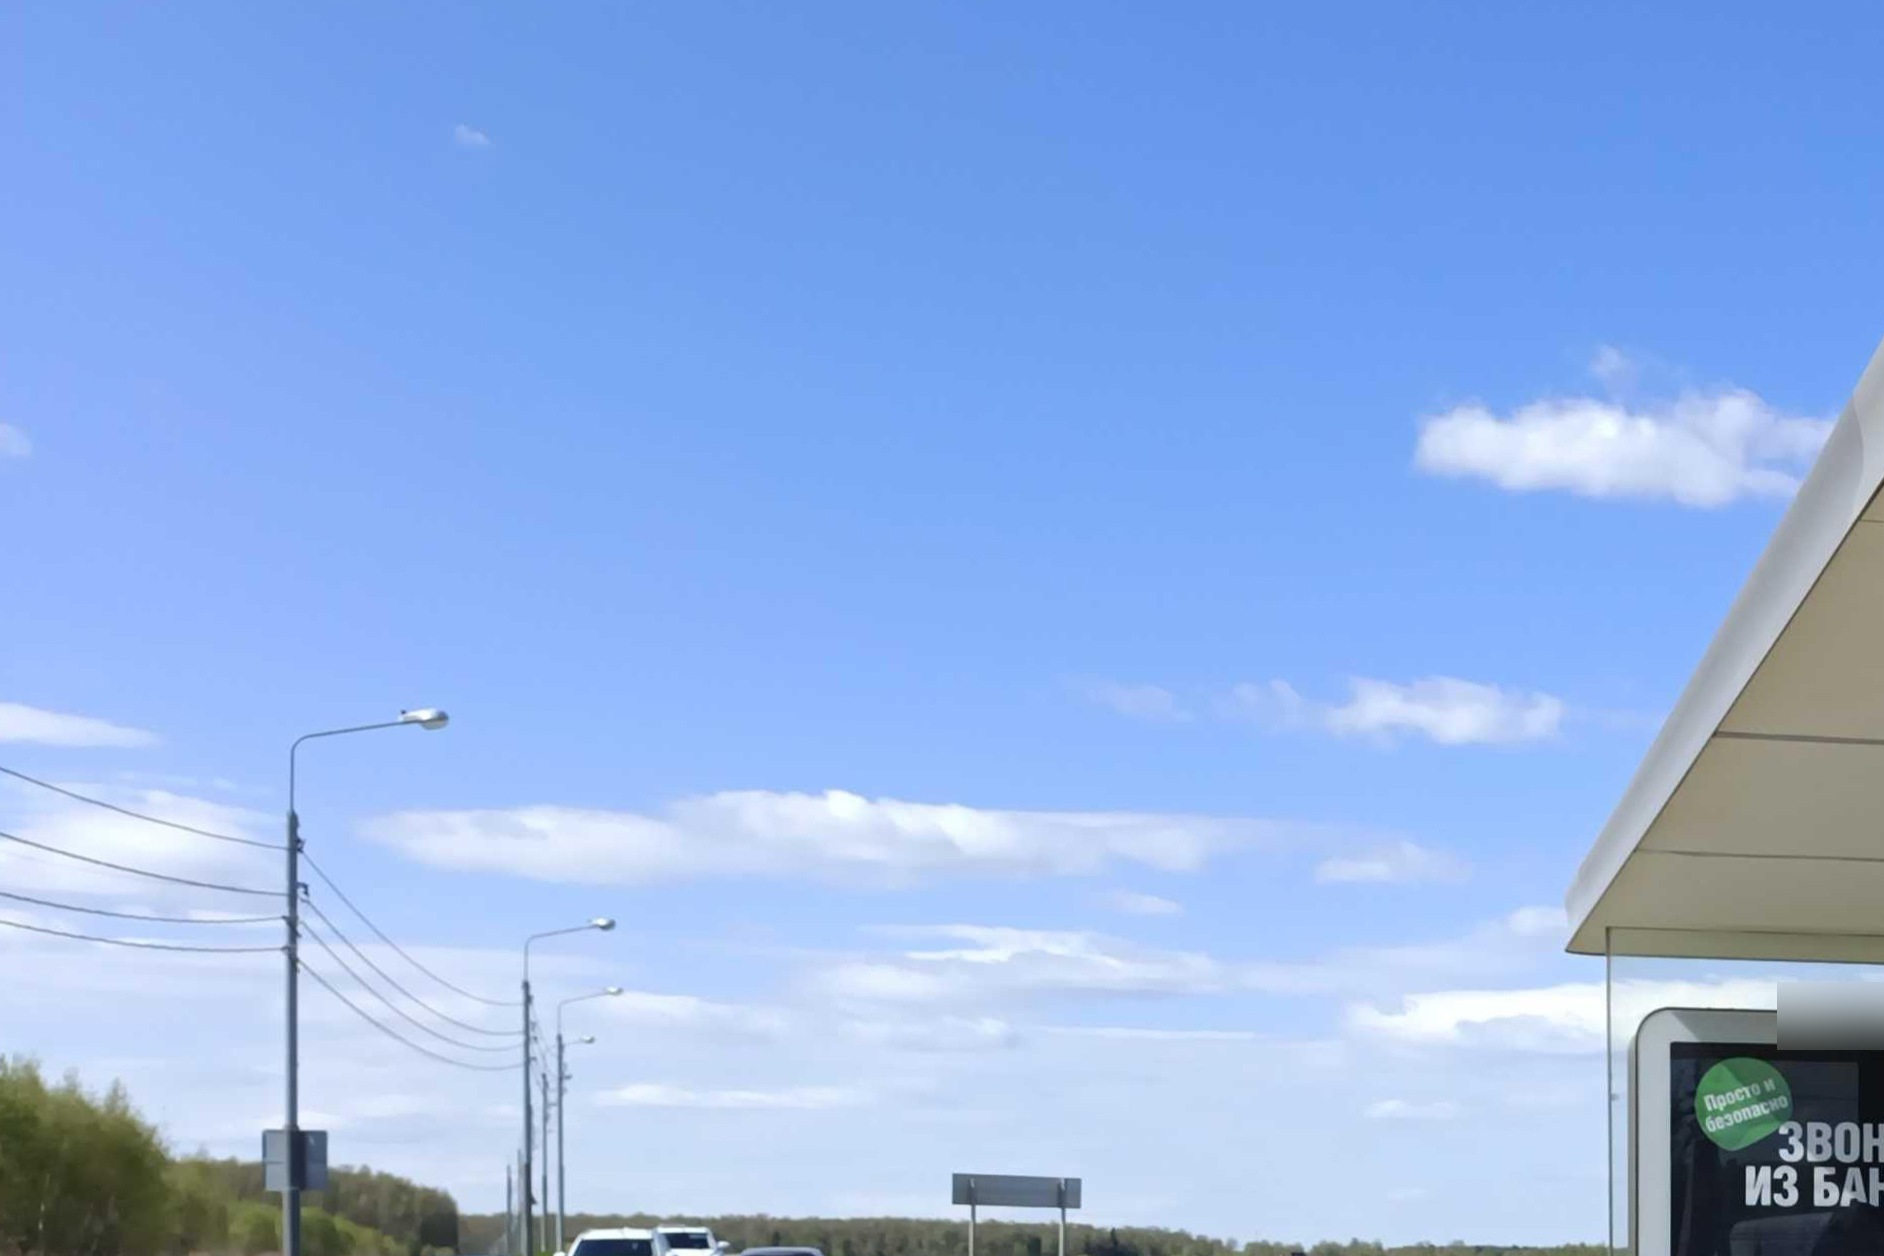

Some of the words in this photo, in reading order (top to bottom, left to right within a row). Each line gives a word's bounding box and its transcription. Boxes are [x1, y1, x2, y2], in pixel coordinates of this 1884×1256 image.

[1704, 1085, 1761, 1111] Просто
[1705, 1095, 1788, 1134] безопасно
[1745, 1165, 1800, 1206] ИЗ
